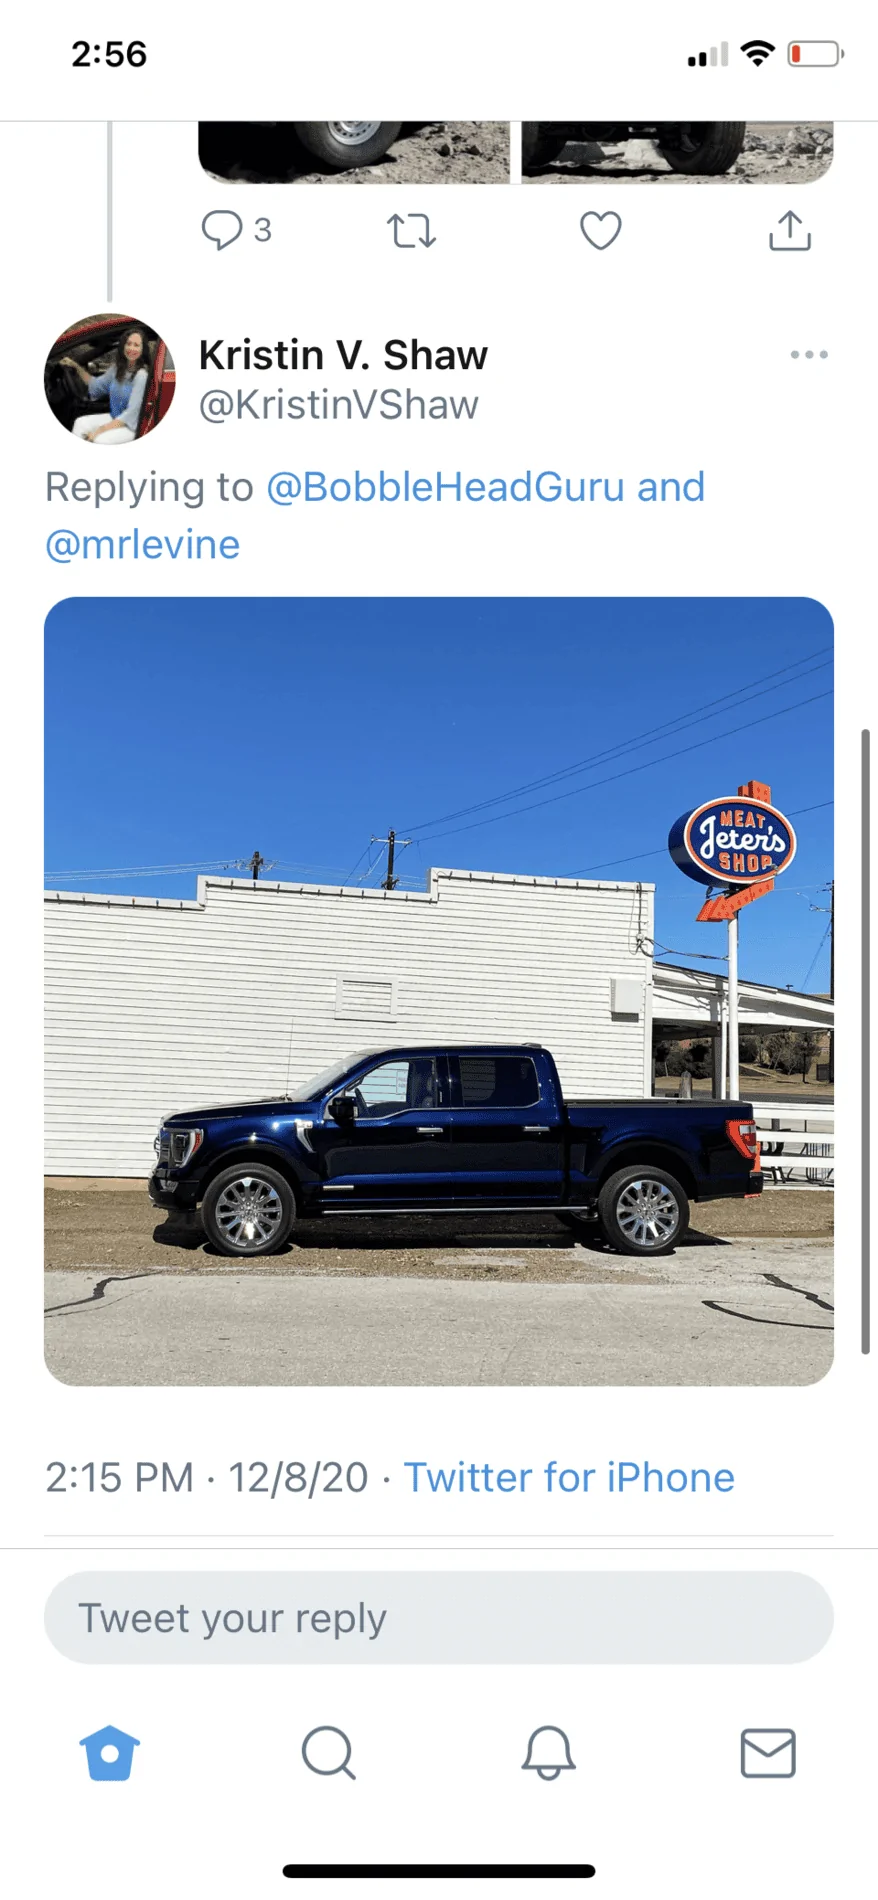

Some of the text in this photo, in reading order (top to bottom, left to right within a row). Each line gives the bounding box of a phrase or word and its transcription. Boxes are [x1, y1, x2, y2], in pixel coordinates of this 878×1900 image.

[72, 40, 147, 67] 2:56
[254, 217, 272, 243] 3
[201, 337, 488, 370] Kristin V. Shaw
[200, 387, 479, 424] @KristinVShaw
[46, 470, 705, 509] Replying to @BobbleHeadGuru and
[46, 528, 240, 564] @mrlevine
[720, 809, 766, 829] MEAT
[699, 815, 787, 860] Jeter's
[718, 851, 773, 873] SHOP
[46, 1460, 735, 1499] 2:15 PM 12/8/20 Twitter for iPhone
[78, 1601, 388, 1641] Tweet your reply
